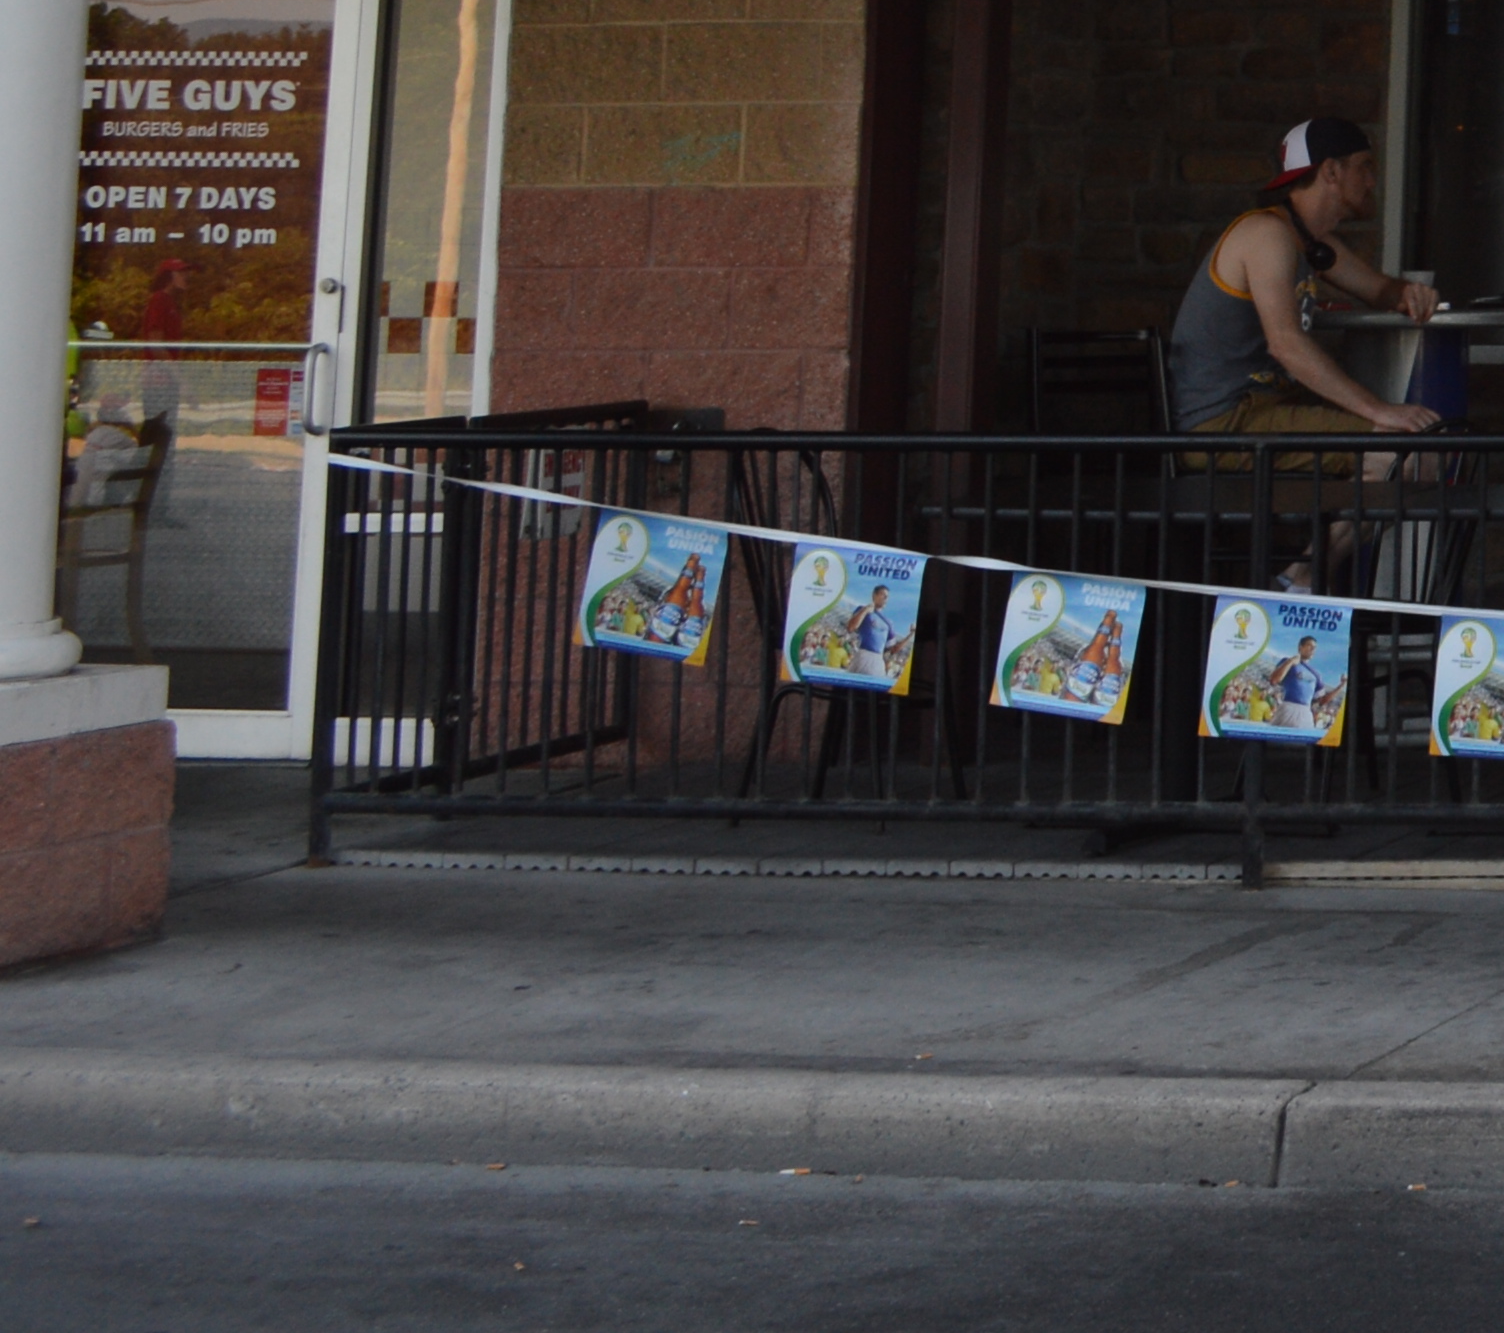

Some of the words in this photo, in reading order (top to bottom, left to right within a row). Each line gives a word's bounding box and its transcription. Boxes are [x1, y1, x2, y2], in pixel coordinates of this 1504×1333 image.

[82, 79, 171, 110] FIVE
[183, 79, 297, 111] GUYS
[102, 121, 183, 137] BURGERS
[186, 122, 217, 138] and
[221, 122, 270, 138] FRIES
[85, 186, 168, 209] OPEN
[175, 187, 193, 209] 7
[200, 187, 276, 210] DAYS
[80, 222, 106, 242] 11
[115, 226, 156, 243] am
[199, 223, 229, 244] 10
[235, 226, 277, 248] pm
[668, 538, 714, 555] UNIDA
[854, 552, 918, 571] PASSION
[858, 564, 911, 582] UNITED
[1084, 595, 1131, 612] UNIDA
[1277, 603, 1343, 622] PASSION
[1282, 615, 1338, 632] UNITED
